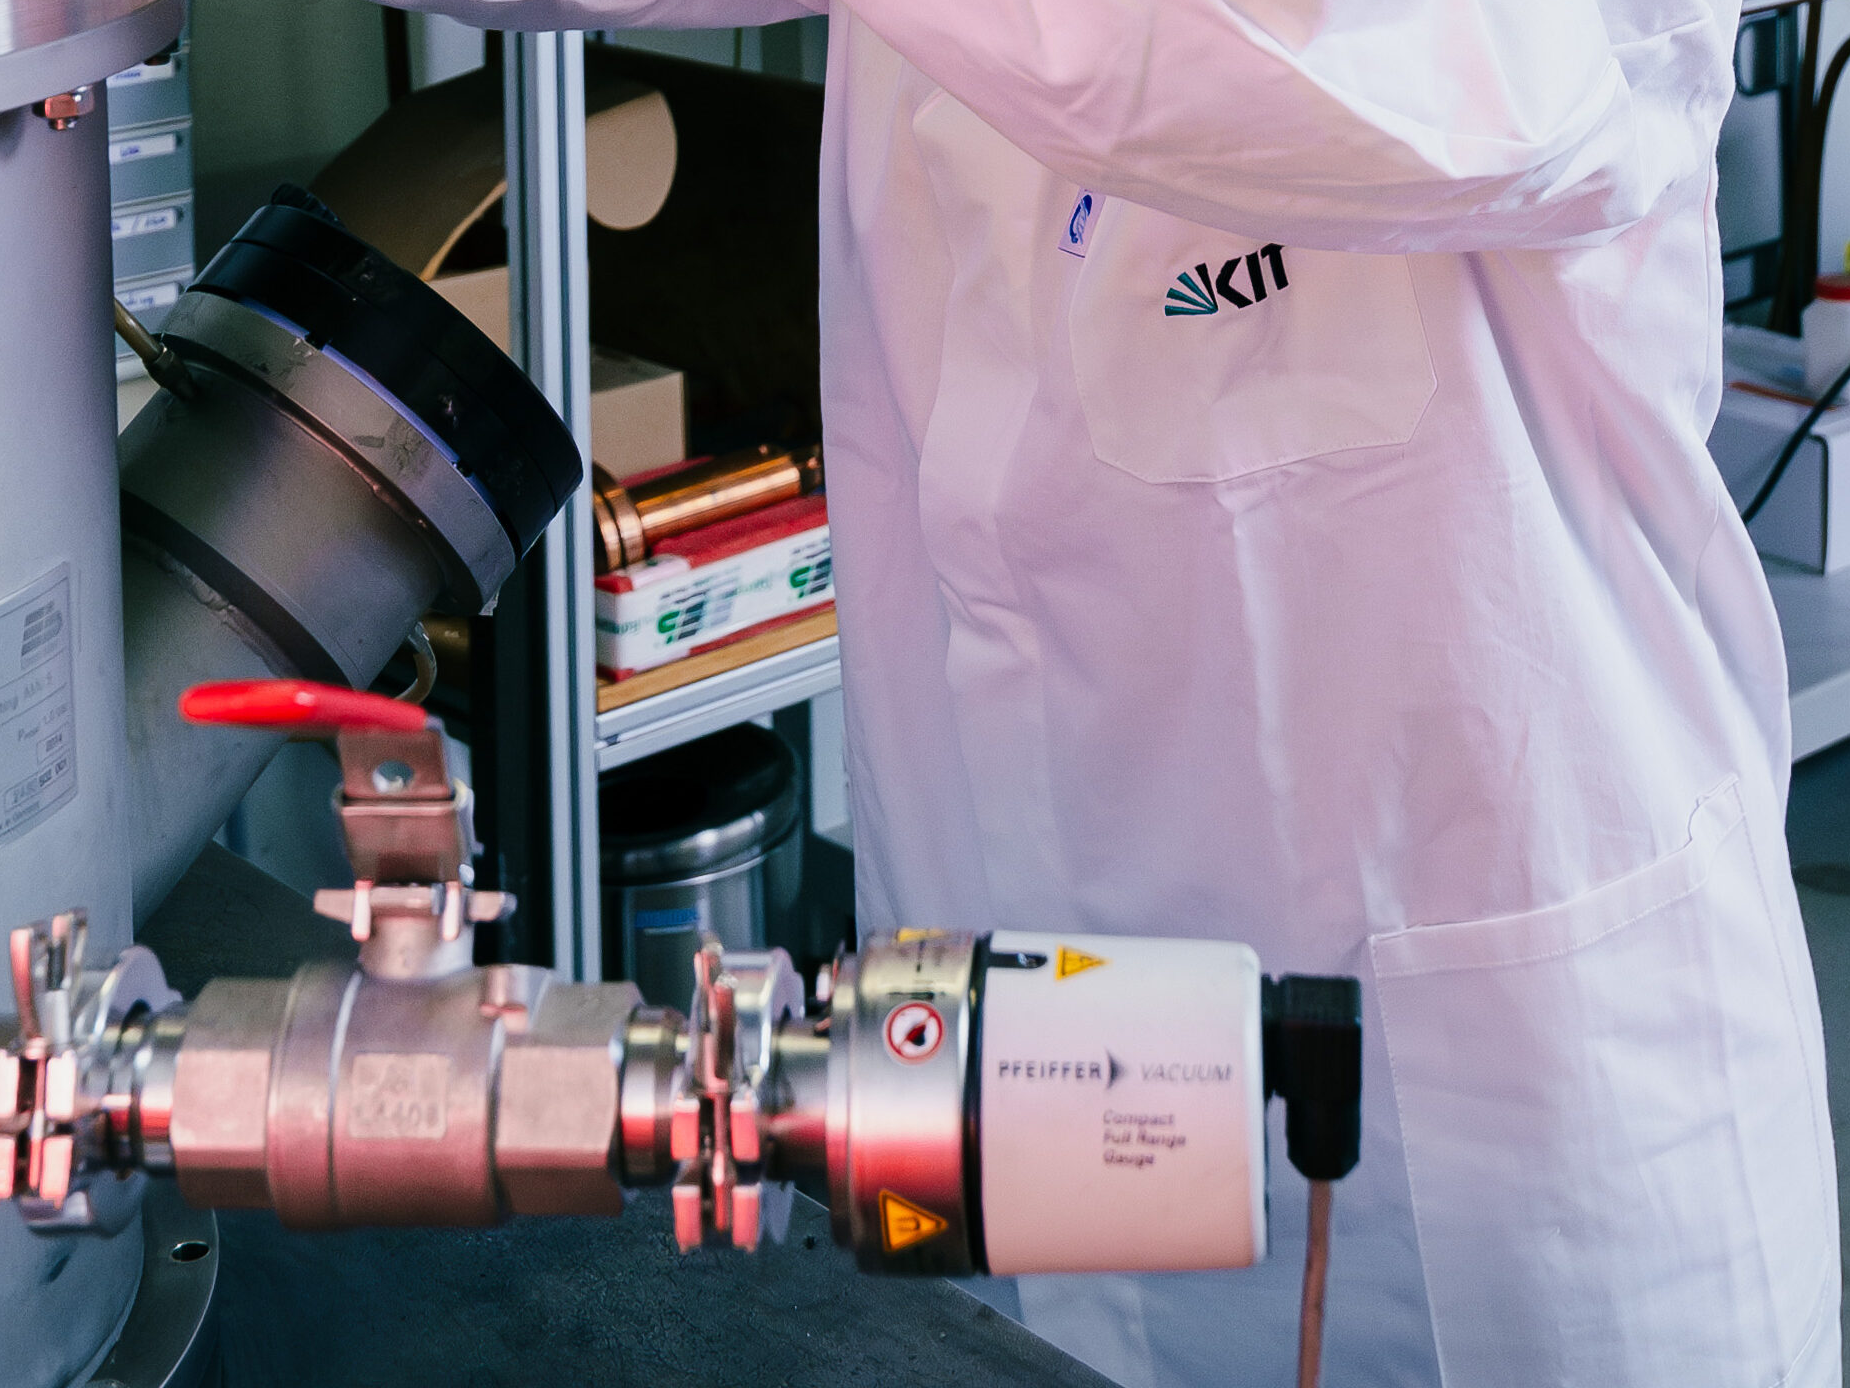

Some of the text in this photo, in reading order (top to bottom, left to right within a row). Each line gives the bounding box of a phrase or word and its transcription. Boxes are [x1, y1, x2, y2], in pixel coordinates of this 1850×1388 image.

[1195, 242, 1289, 309] KIT
[998, 1061, 1232, 1082] PFEIFFER VACUUM
[1103, 1111, 1174, 1127] Compact
[1103, 1130, 1187, 1149] Full Range
[1103, 1150, 1155, 1168] Gauge
